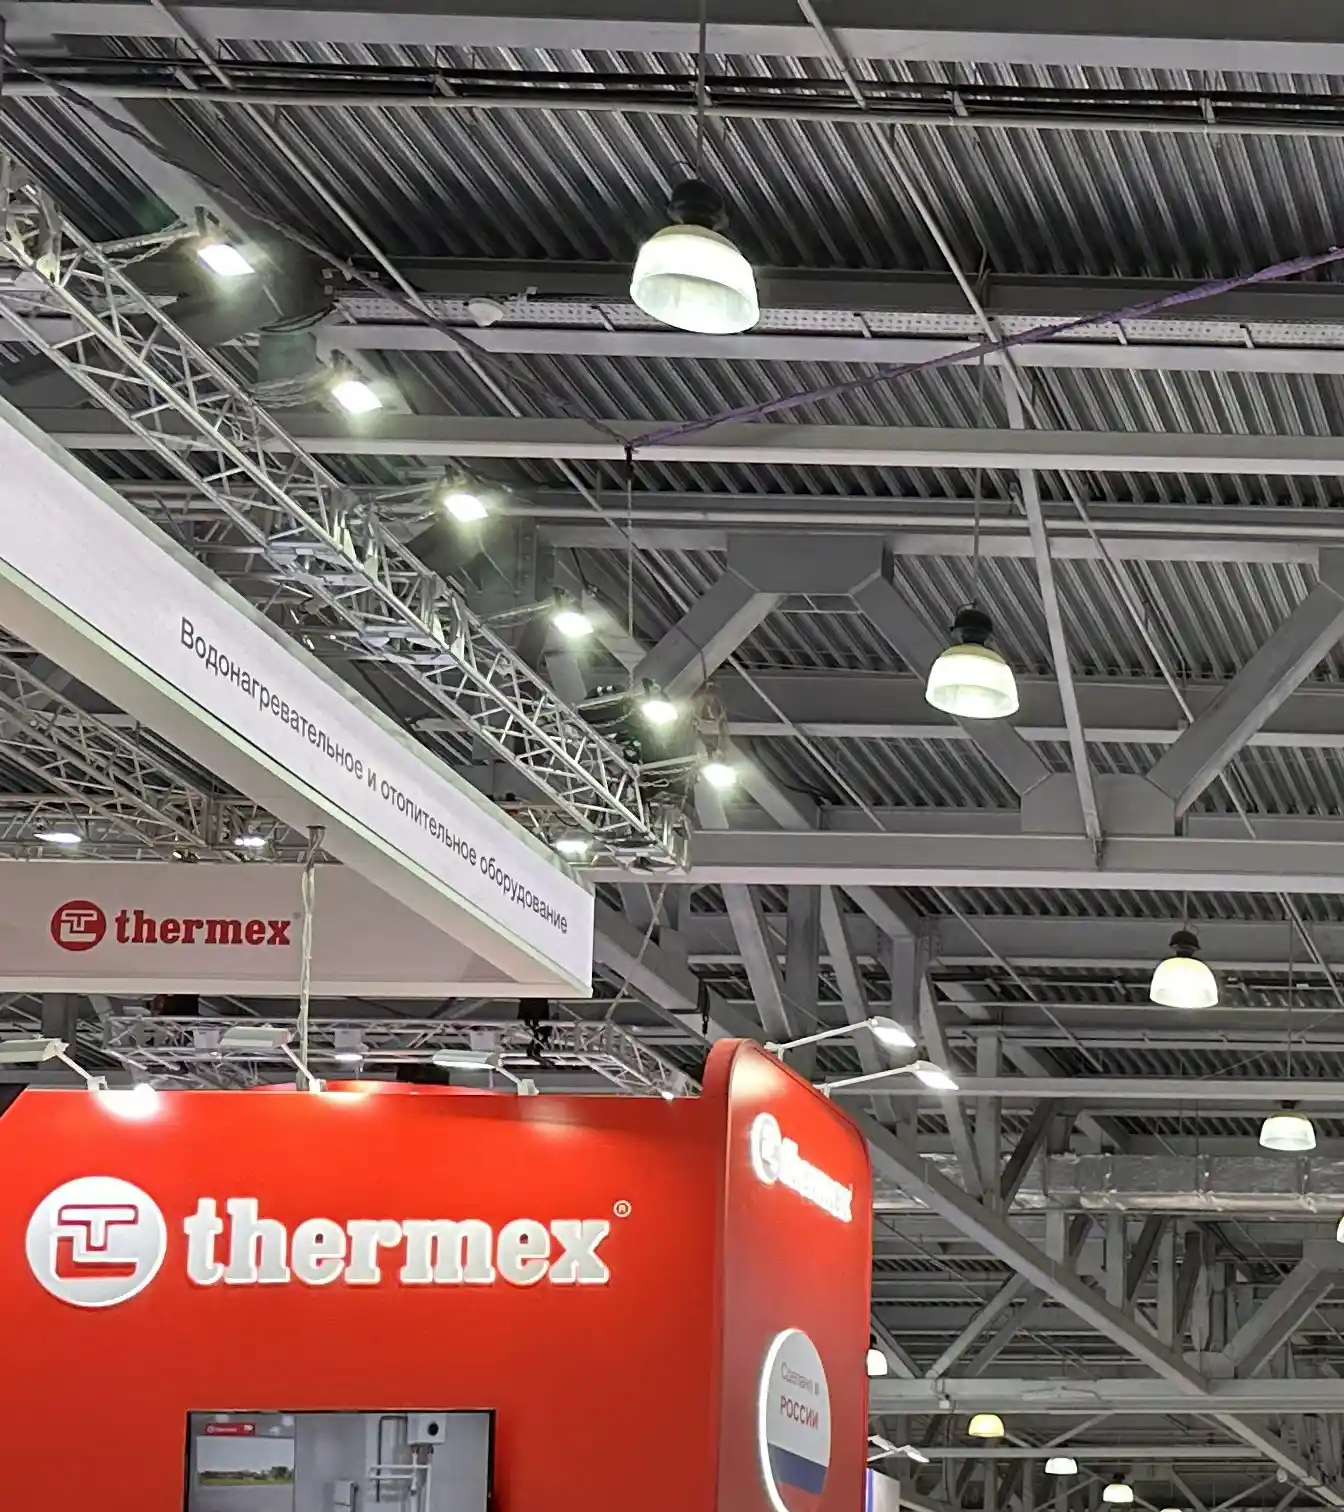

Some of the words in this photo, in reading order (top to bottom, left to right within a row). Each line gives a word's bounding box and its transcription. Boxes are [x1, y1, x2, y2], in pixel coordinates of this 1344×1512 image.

[181, 616, 363, 780] Водонагревательное
[367, 767, 377, 792] и
[380, 779, 477, 867] отопительное
[480, 855, 569, 935] оборудование
[114, 909, 292, 946] thermex
[183, 1196, 613, 1287] thermex
[780, 1395, 819, 1431] РОССИИ
